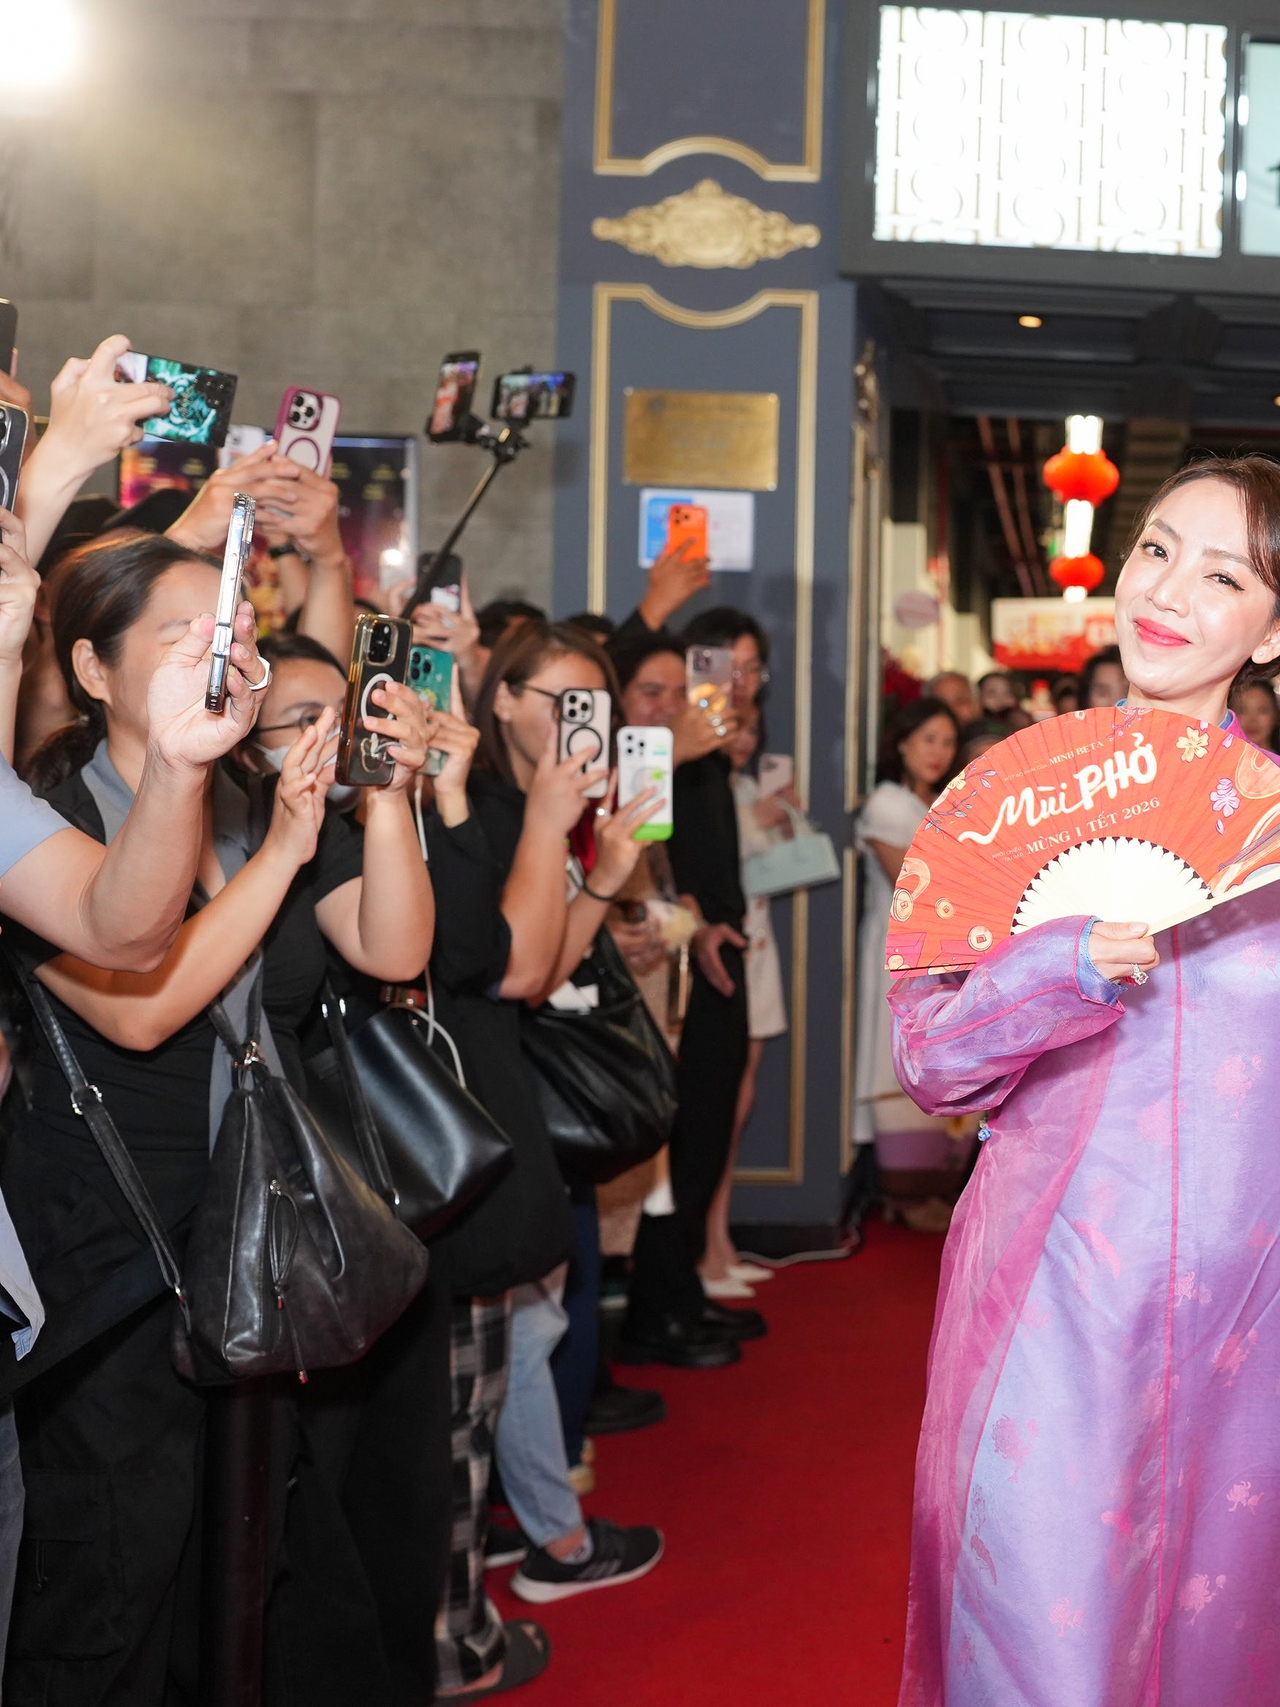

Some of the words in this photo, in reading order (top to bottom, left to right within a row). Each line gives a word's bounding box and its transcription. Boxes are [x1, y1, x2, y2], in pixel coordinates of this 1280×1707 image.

[1048, 750, 1075, 766] MINH
[1075, 741, 1105, 756] BETA
[1026, 830, 1071, 855] MÙNG
[1075, 826, 1083, 838] 1
[1086, 810, 1118, 833] TẾT
[1121, 796, 1161, 820] 2026
